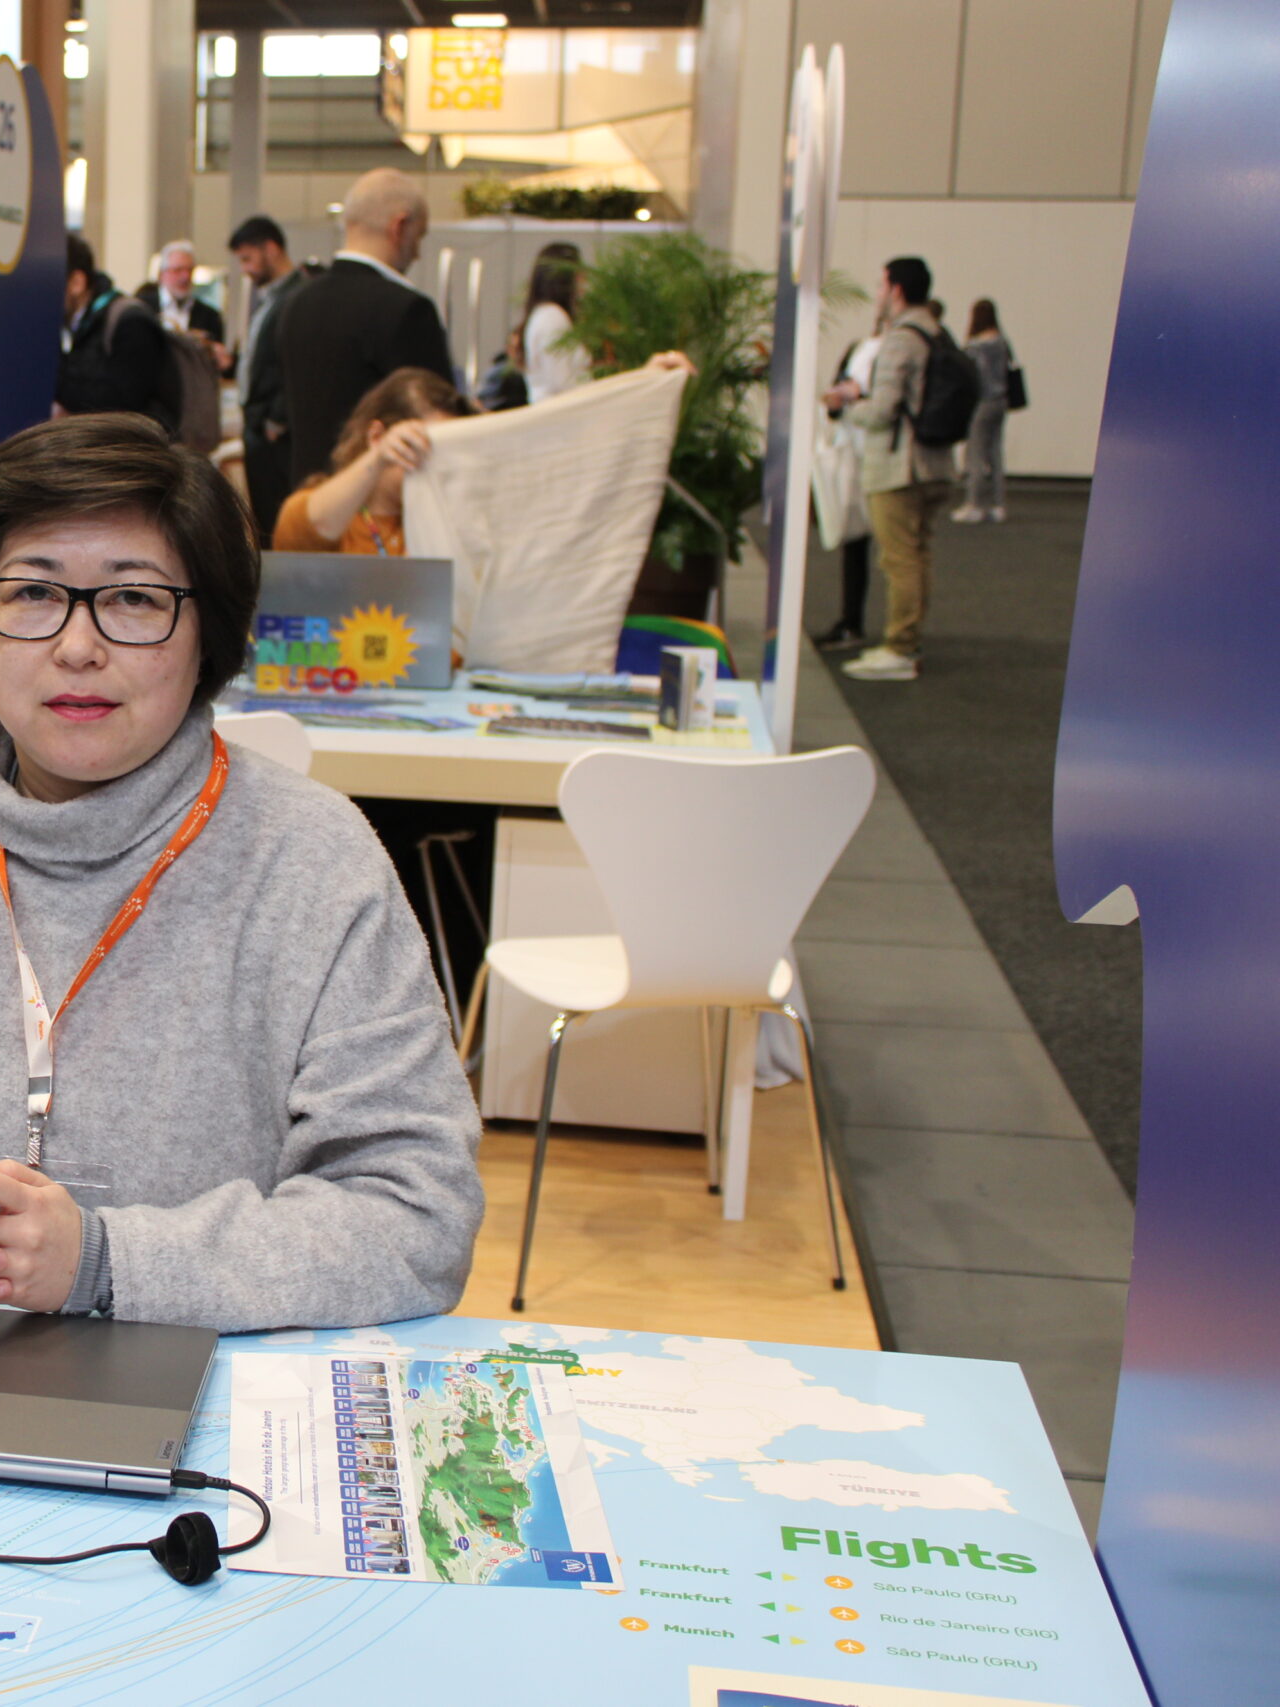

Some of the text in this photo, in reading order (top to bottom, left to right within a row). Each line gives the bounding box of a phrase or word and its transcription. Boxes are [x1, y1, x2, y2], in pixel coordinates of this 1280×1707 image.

[258, 615, 329, 641] PER
[256, 638, 339, 667] NAM
[256, 664, 358, 693] BUCO
[781, 1526, 1038, 1574] Flights
[639, 1559, 1018, 1605] Frankfurt São Paulo (GRU)
[640, 1588, 1059, 1640] Frankfurt Rio de Janeiro (GIG)
[664, 1624, 1038, 1671] Munich São Paulo (GRU)
